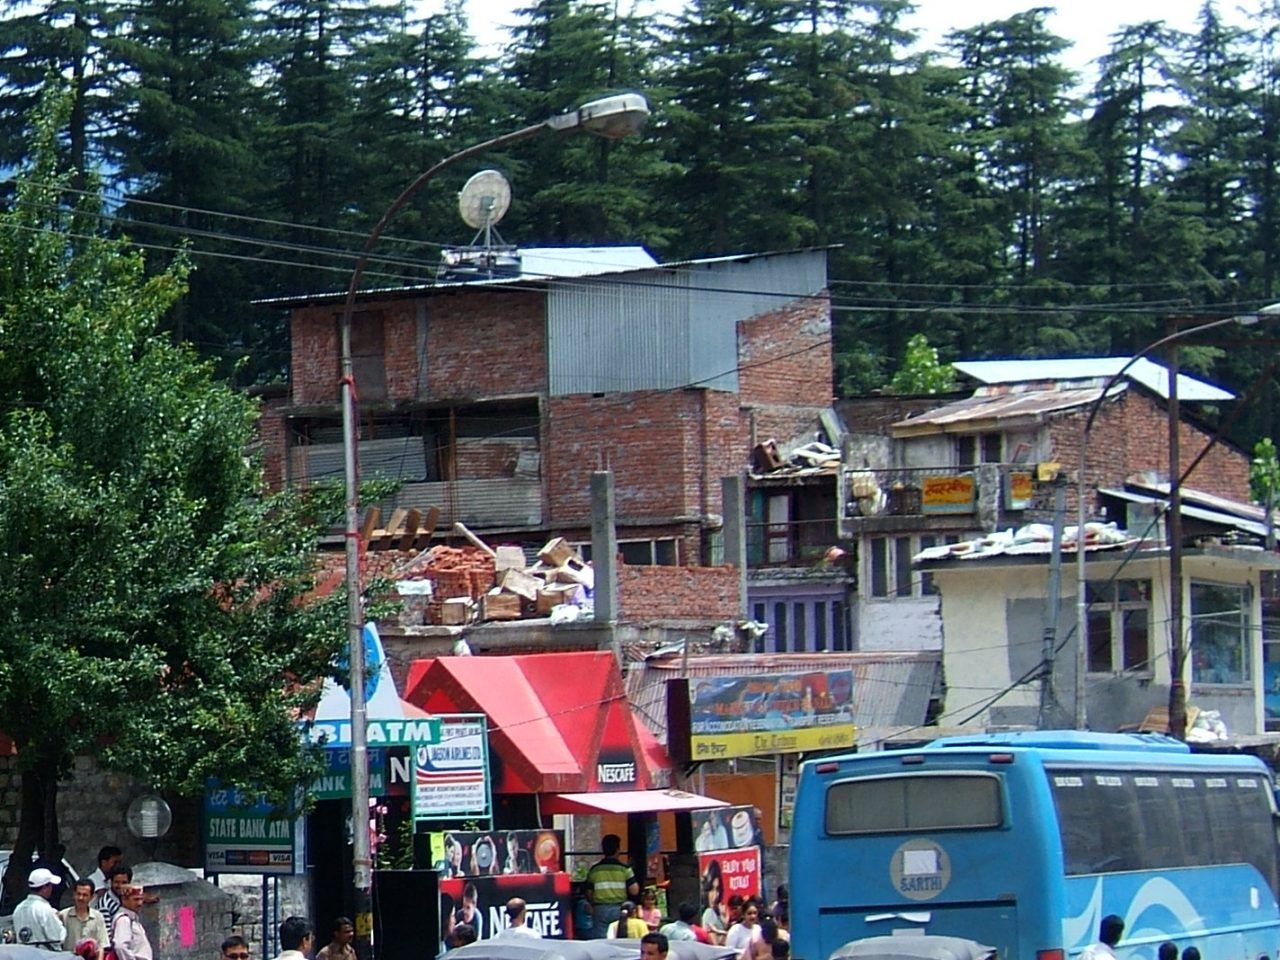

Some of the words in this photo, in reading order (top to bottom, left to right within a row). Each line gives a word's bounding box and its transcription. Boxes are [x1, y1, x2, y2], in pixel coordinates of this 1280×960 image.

[366, 721, 432, 742] ATM
[209, 818, 236, 838] STATE
[239, 819, 266, 838] BANK
[269, 820, 290, 838] ATM
[900, 877, 943, 891] SARTHI
